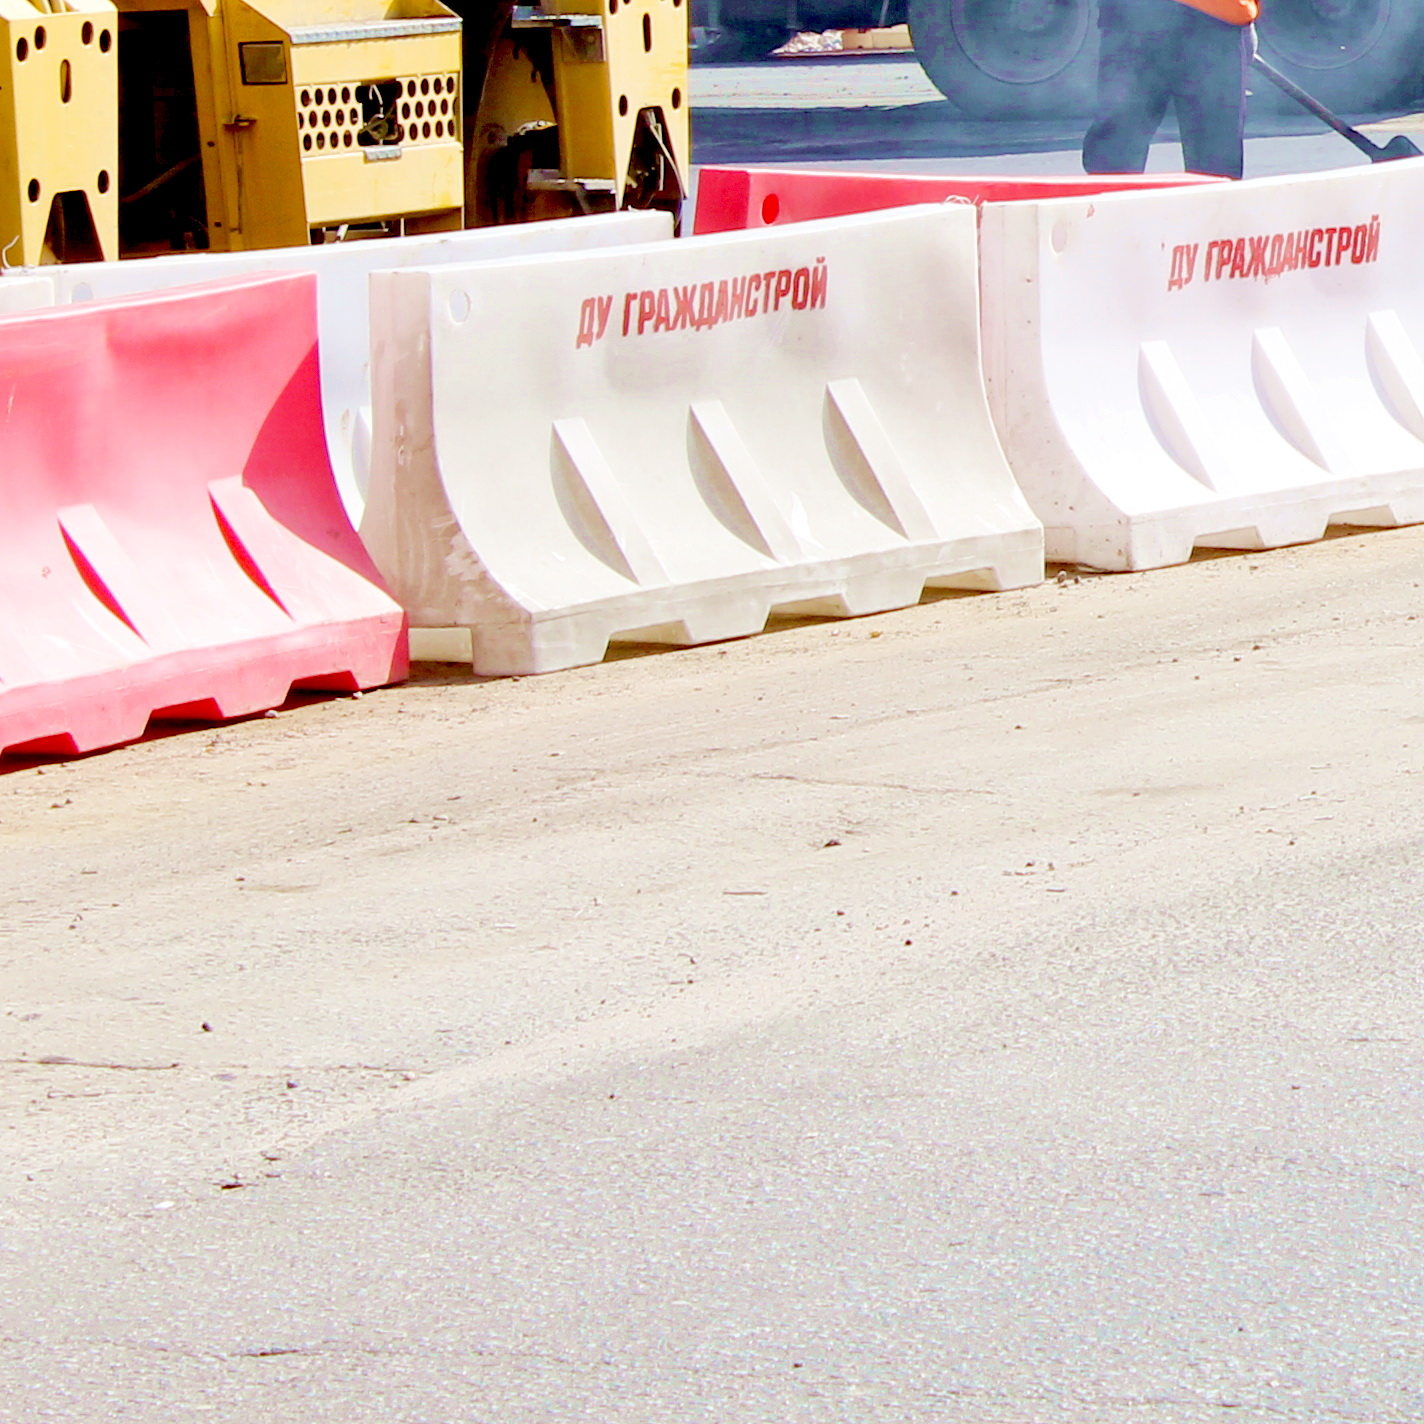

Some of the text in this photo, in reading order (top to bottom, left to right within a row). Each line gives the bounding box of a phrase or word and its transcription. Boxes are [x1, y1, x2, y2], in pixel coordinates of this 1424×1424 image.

[1167, 214, 1380, 291] ДУ ГРАЖДАНСТРОЙ
[576, 256, 828, 349] ДУ ГРАЖДАНСТРОЙ
